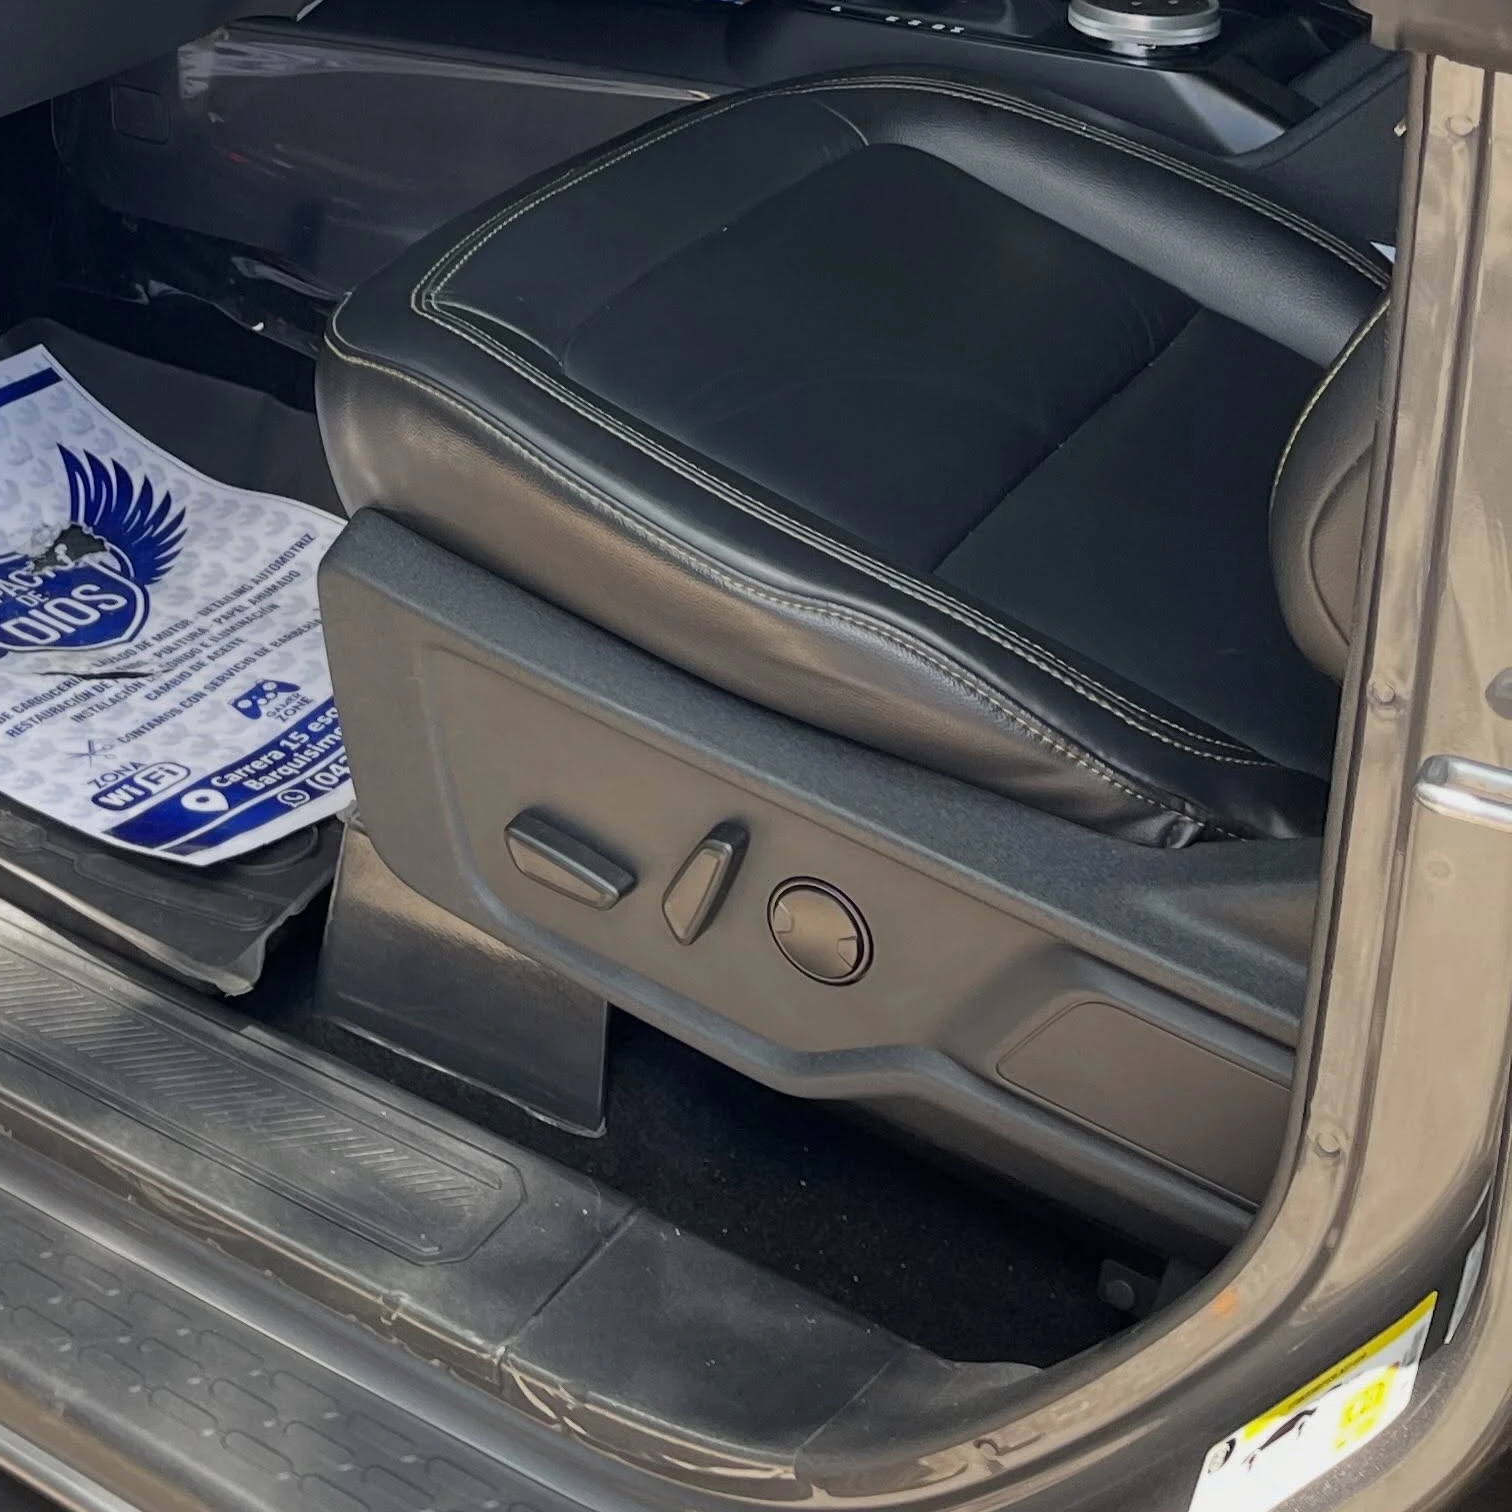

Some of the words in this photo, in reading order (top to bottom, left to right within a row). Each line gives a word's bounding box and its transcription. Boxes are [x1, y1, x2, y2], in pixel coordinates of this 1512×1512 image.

[0, 583, 128, 645] DIOS
[15, 590, 49, 607] DE
[136, 638, 153, 654] DE
[152, 617, 192, 646] MOTOR
[196, 582, 254, 619] DETAILING
[248, 532, 316, 586] AUTOMOTRIZ
[4, 687, 94, 740] RESTAURACIÓN
[91, 679, 113, 695] DE
[152, 626, 211, 660] POLITURA
[212, 603, 251, 627] PAPEL
[247, 569, 301, 606] AHUMADO
[69, 679, 147, 725] INSTALACIÓN
[211, 602, 281, 647] ILUMINACIÓN
[144, 669, 194, 702] CAMBIO
[192, 659, 209, 674] DE
[206, 637, 248, 663] ACEITE
[117, 706, 183, 745] CONTAMOS
[178, 690, 208, 710] CON
[203, 655, 258, 692] SERVICIO
[256, 645, 273, 659] DE
[266, 691, 303, 719] GAMER
[275, 696, 314, 723] ZONE
[91, 761, 146, 789] ZONA
[209, 747, 286, 789] Carrera
[279, 731, 310, 752] 15
